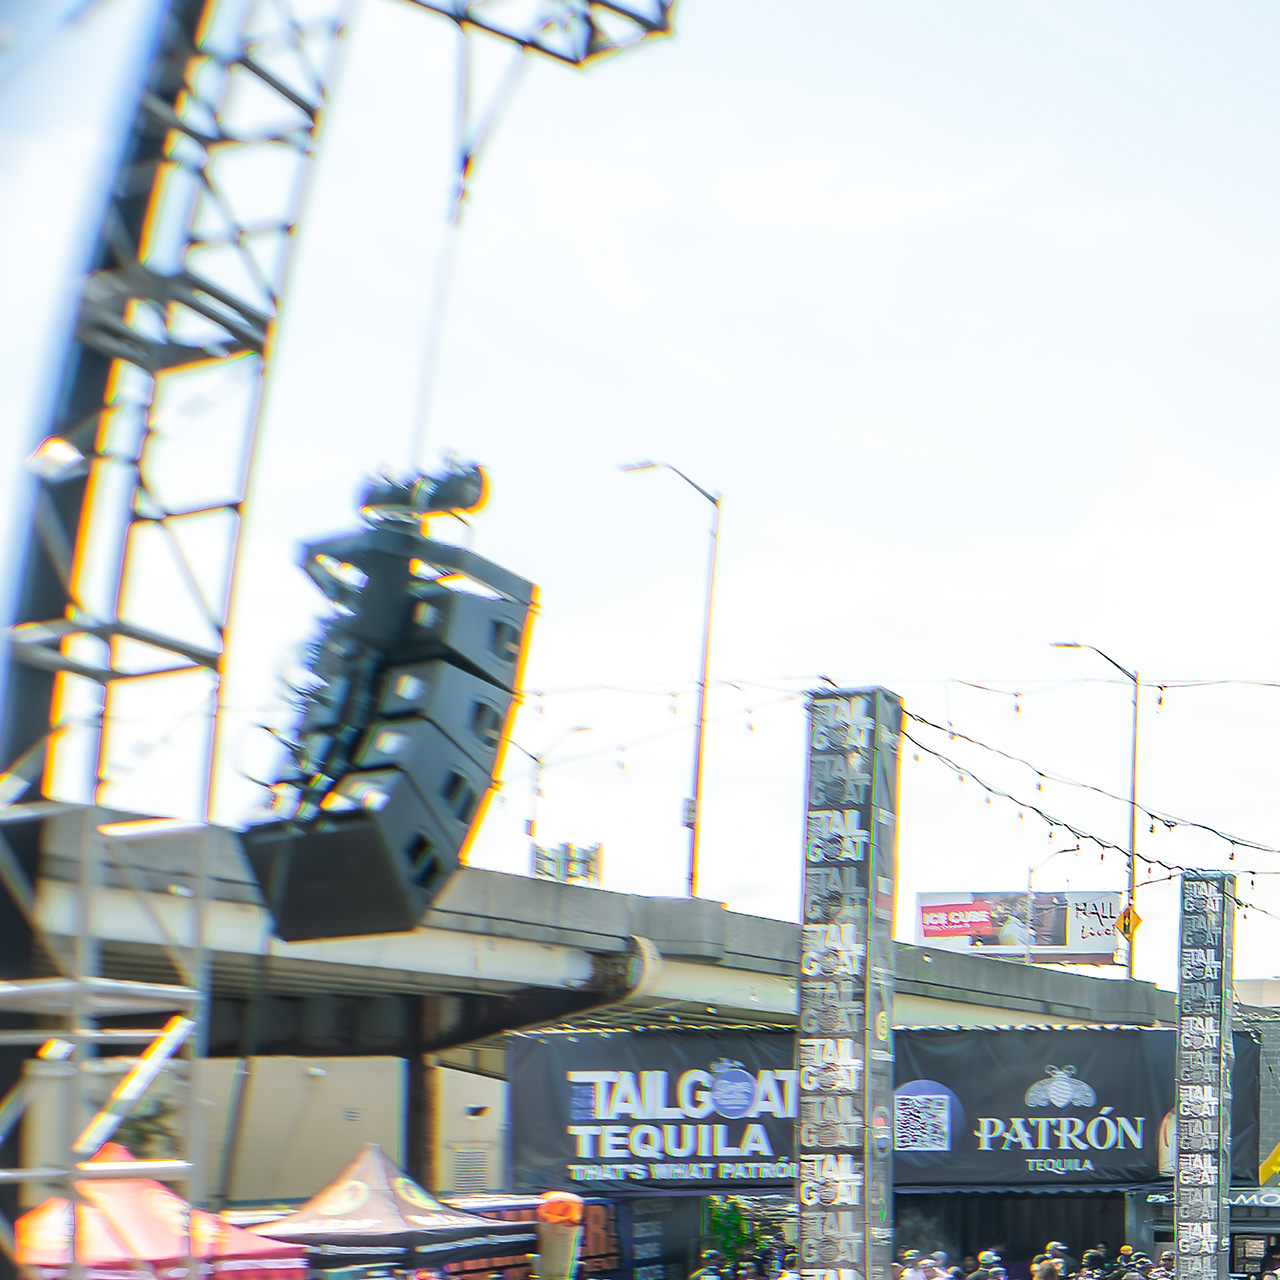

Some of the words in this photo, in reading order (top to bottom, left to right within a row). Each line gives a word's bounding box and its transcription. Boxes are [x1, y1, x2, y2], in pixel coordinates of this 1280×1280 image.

[813, 698, 874, 729] TAIL
[808, 810, 869, 839] TAIL
[1184, 880, 1223, 899] TAIL
[923, 912, 948, 925] ICE
[802, 924, 865, 953] TAIL
[1182, 948, 1221, 967] TAIL
[1181, 1016, 1220, 1036] TAIL
[800, 1038, 864, 1069] TAIL
[1180, 1051, 1219, 1070] TAIL
[1179, 1085, 1218, 1104] TAIL
[801, 1096, 863, 1124] TAIL
[973, 1106, 1147, 1151] PATRÓN
[1179, 1119, 1218, 1137] TAIL
[567, 1124, 774, 1160] TEQUILA
[567, 1163, 648, 1181] THAT'S
[649, 1162, 716, 1180] WHAT
[800, 1154, 864, 1185] TAIL
[1025, 1158, 1095, 1175] TEQUILA
[1179, 1153, 1218, 1174] TAIL
[1179, 1187, 1217, 1207] TAIL
[801, 1212, 863, 1240] TAIL
[1179, 1222, 1217, 1242] TAIL
[1179, 1256, 1217, 1274] TAIL
